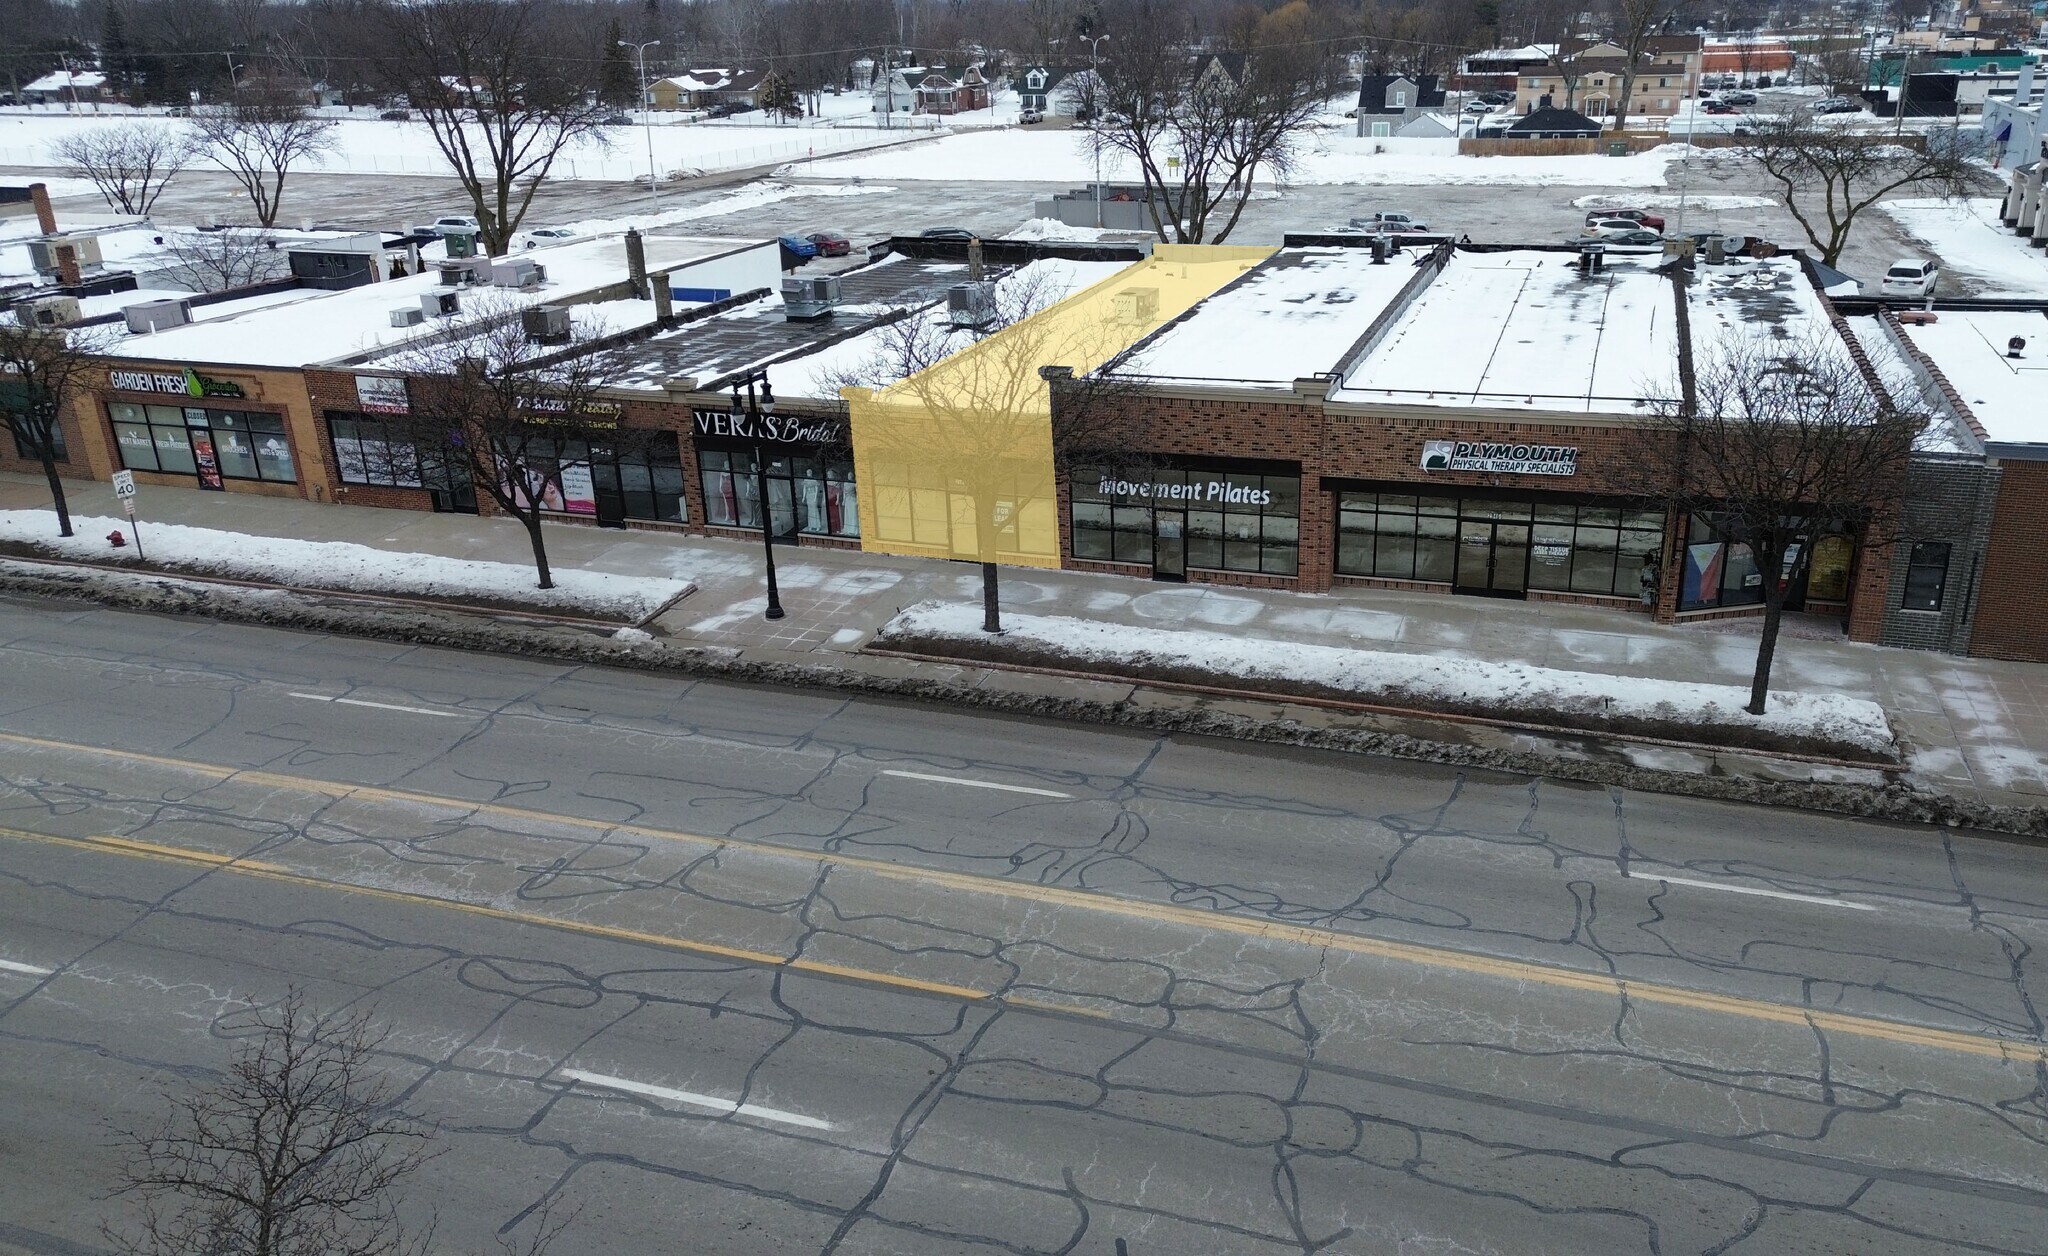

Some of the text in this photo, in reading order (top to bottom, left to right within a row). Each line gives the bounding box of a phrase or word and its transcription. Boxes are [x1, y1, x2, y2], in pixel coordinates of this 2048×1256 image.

[111, 371, 188, 394] GARDEN FRESH
[777, 417, 841, 442] Bridal
[1454, 442, 1577, 463] PLYMOUTH
[1452, 459, 1575, 475] PHYSICAL THERAPY SPECIALISTS
[118, 484, 134, 494] 40
[1099, 476, 1271, 505] Movement Pilates
